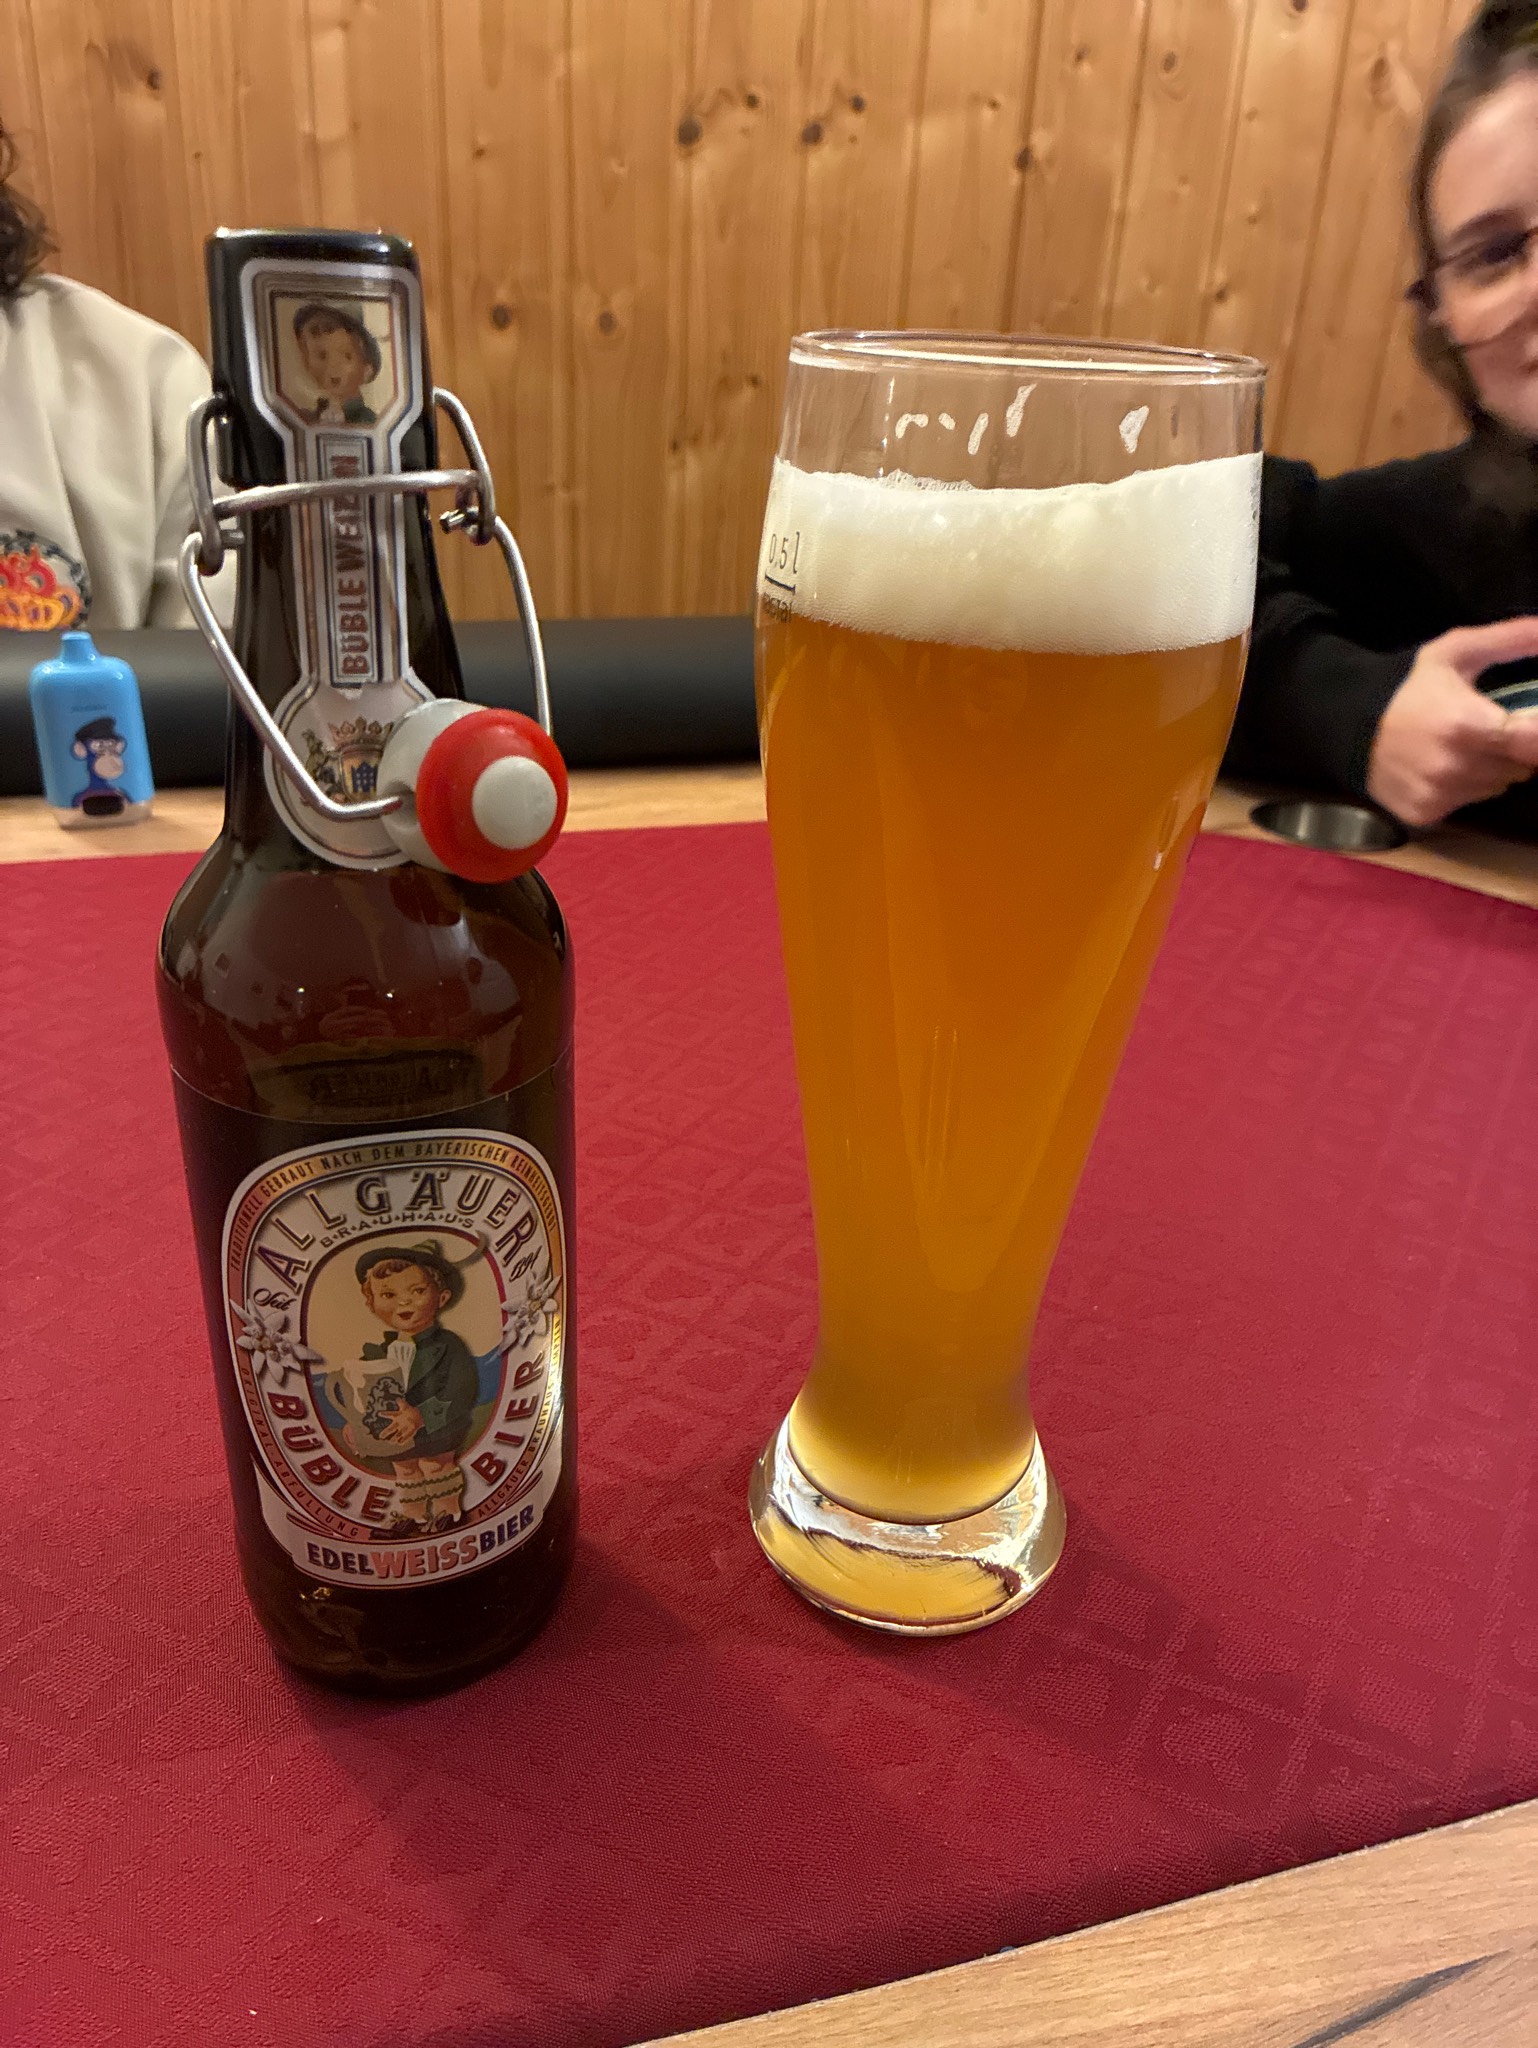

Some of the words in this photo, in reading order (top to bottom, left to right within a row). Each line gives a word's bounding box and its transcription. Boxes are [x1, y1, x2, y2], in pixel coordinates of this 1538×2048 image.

[331, 455, 366, 573] WEIZN
[338, 578, 371, 675] BÜBLE
[230, 1193, 263, 1272] TRADITIONELL
[260, 1161, 315, 1198] GEBRAUT
[320, 1151, 363, 1170] NACH
[372, 1146, 406, 1161] DEM
[415, 1142, 511, 1164] BAYERISCHEN
[510, 1153, 557, 1232] REINHEITSGEBOT
[255, 1169, 538, 1294] ALLGÄUER
[253, 1287, 298, 1312] Seit
[267, 1391, 394, 1521] BÜBLE
[471, 1350, 545, 1486] BIER
[528, 1383, 555, 1453] BRAUHAUS
[306, 1504, 535, 1579] EDELWEISSBIER
